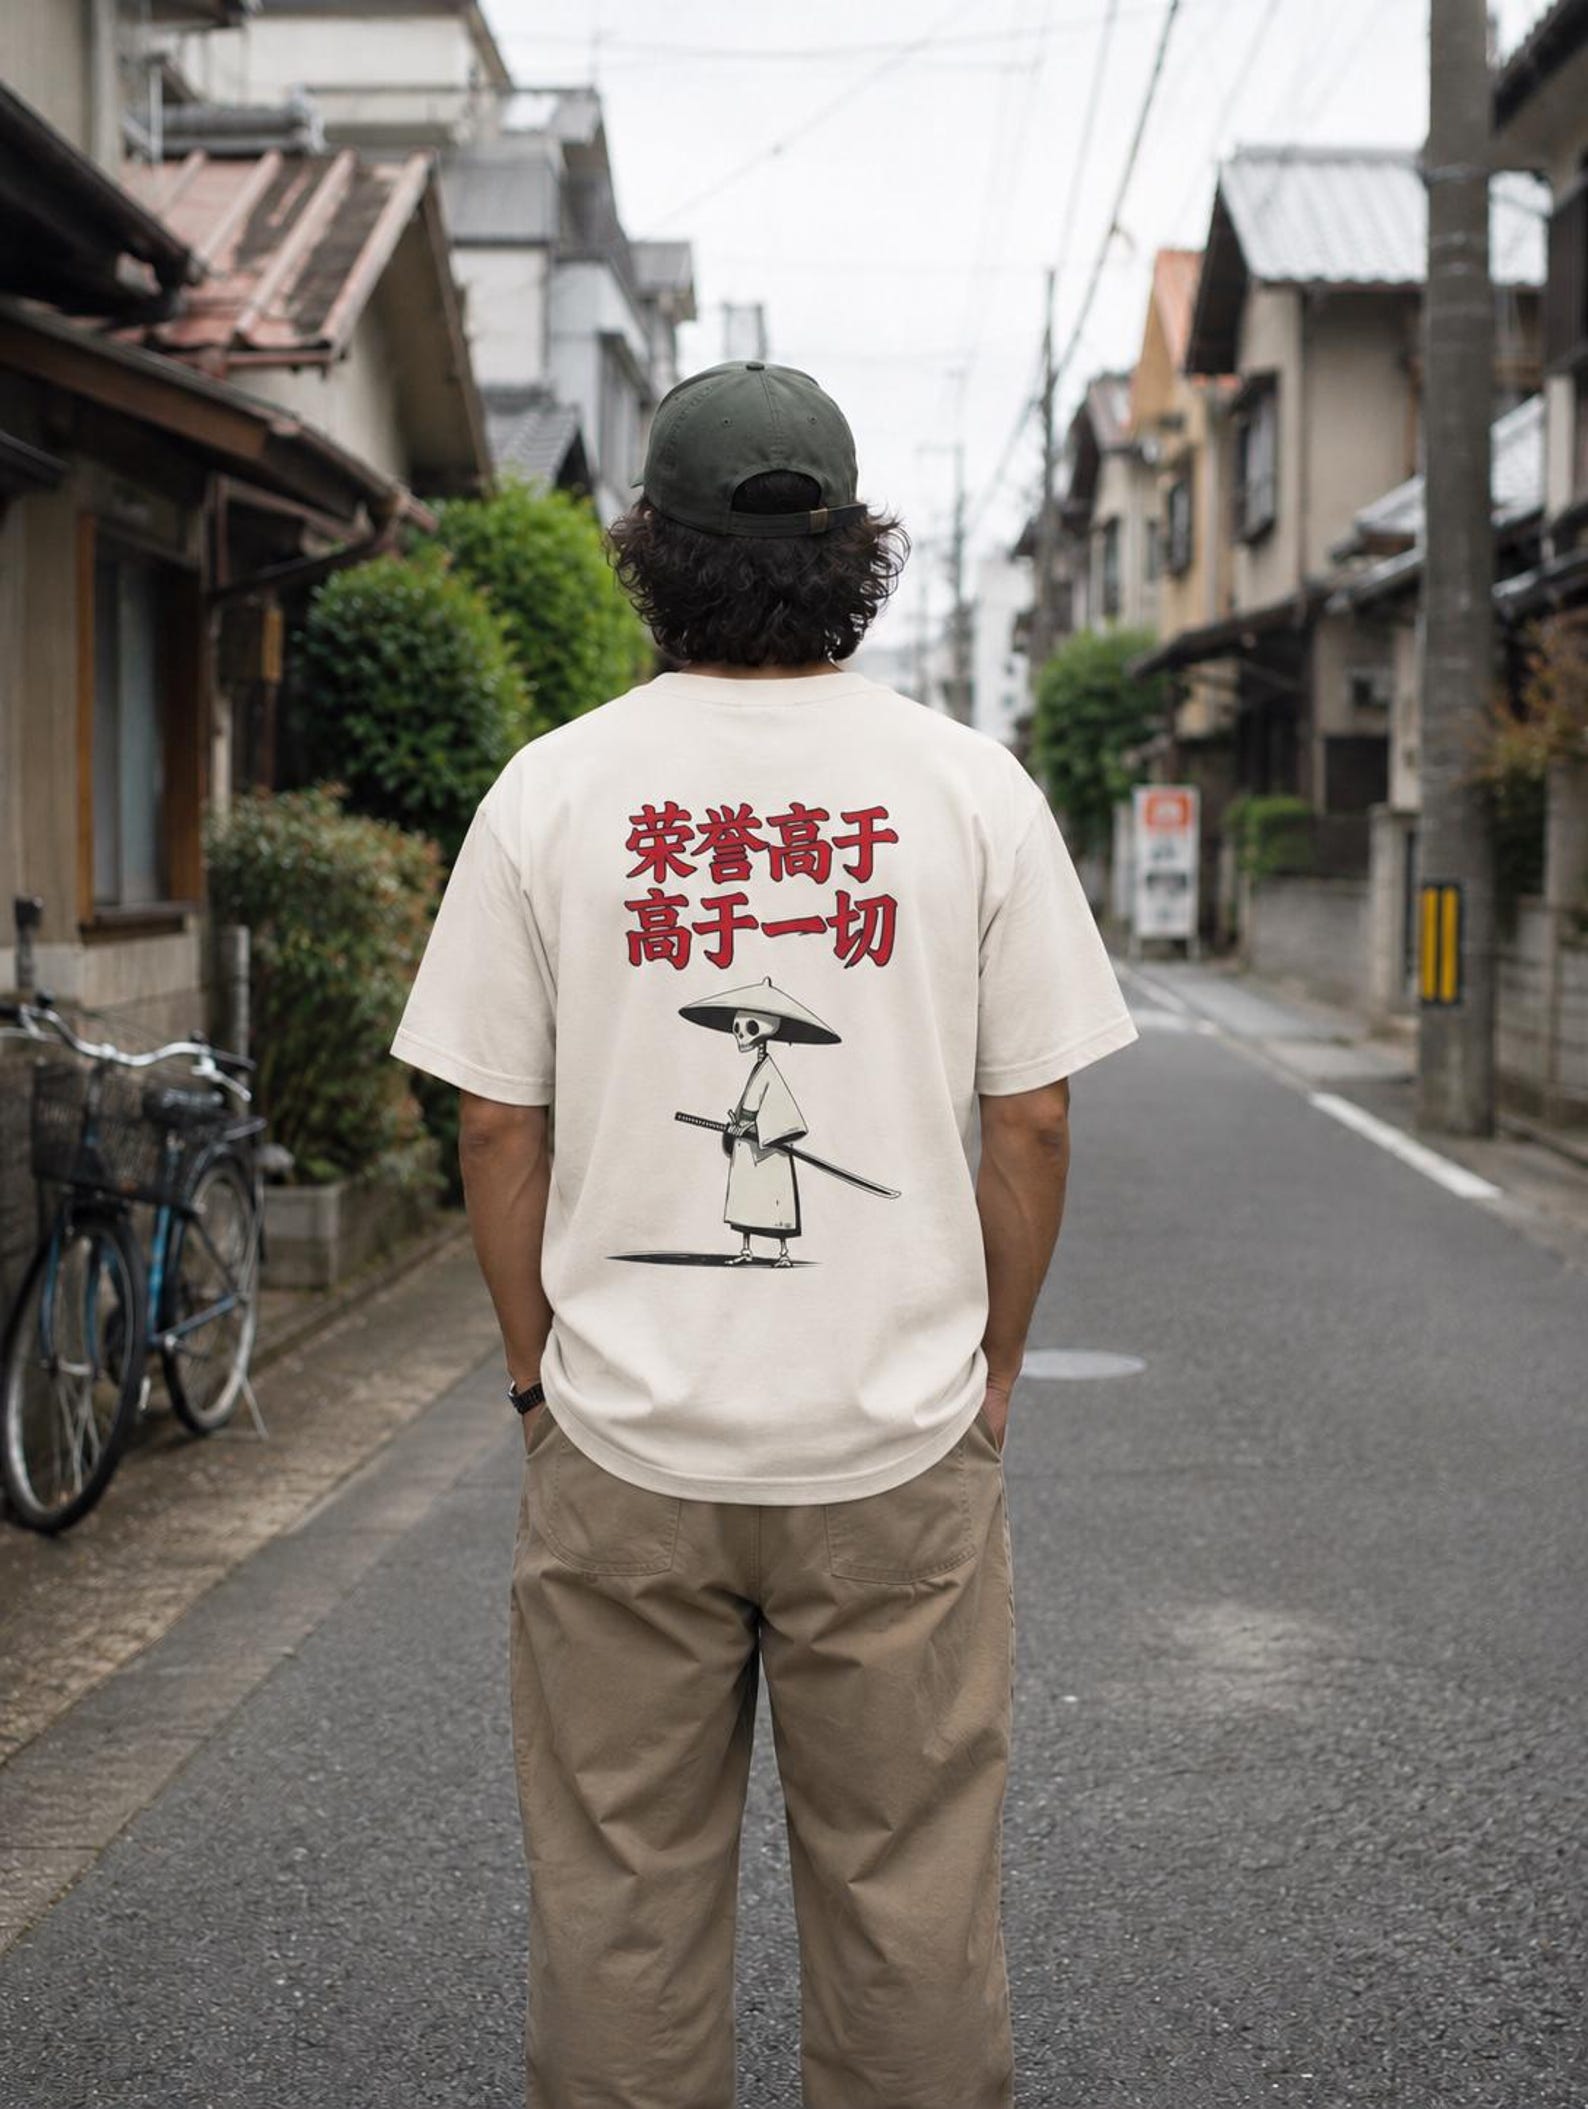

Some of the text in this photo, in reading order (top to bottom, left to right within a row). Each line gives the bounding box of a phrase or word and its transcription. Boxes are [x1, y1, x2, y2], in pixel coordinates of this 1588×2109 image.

[625, 801, 899, 884] 荣誉高于
[624, 888, 898, 970] 高于一切
